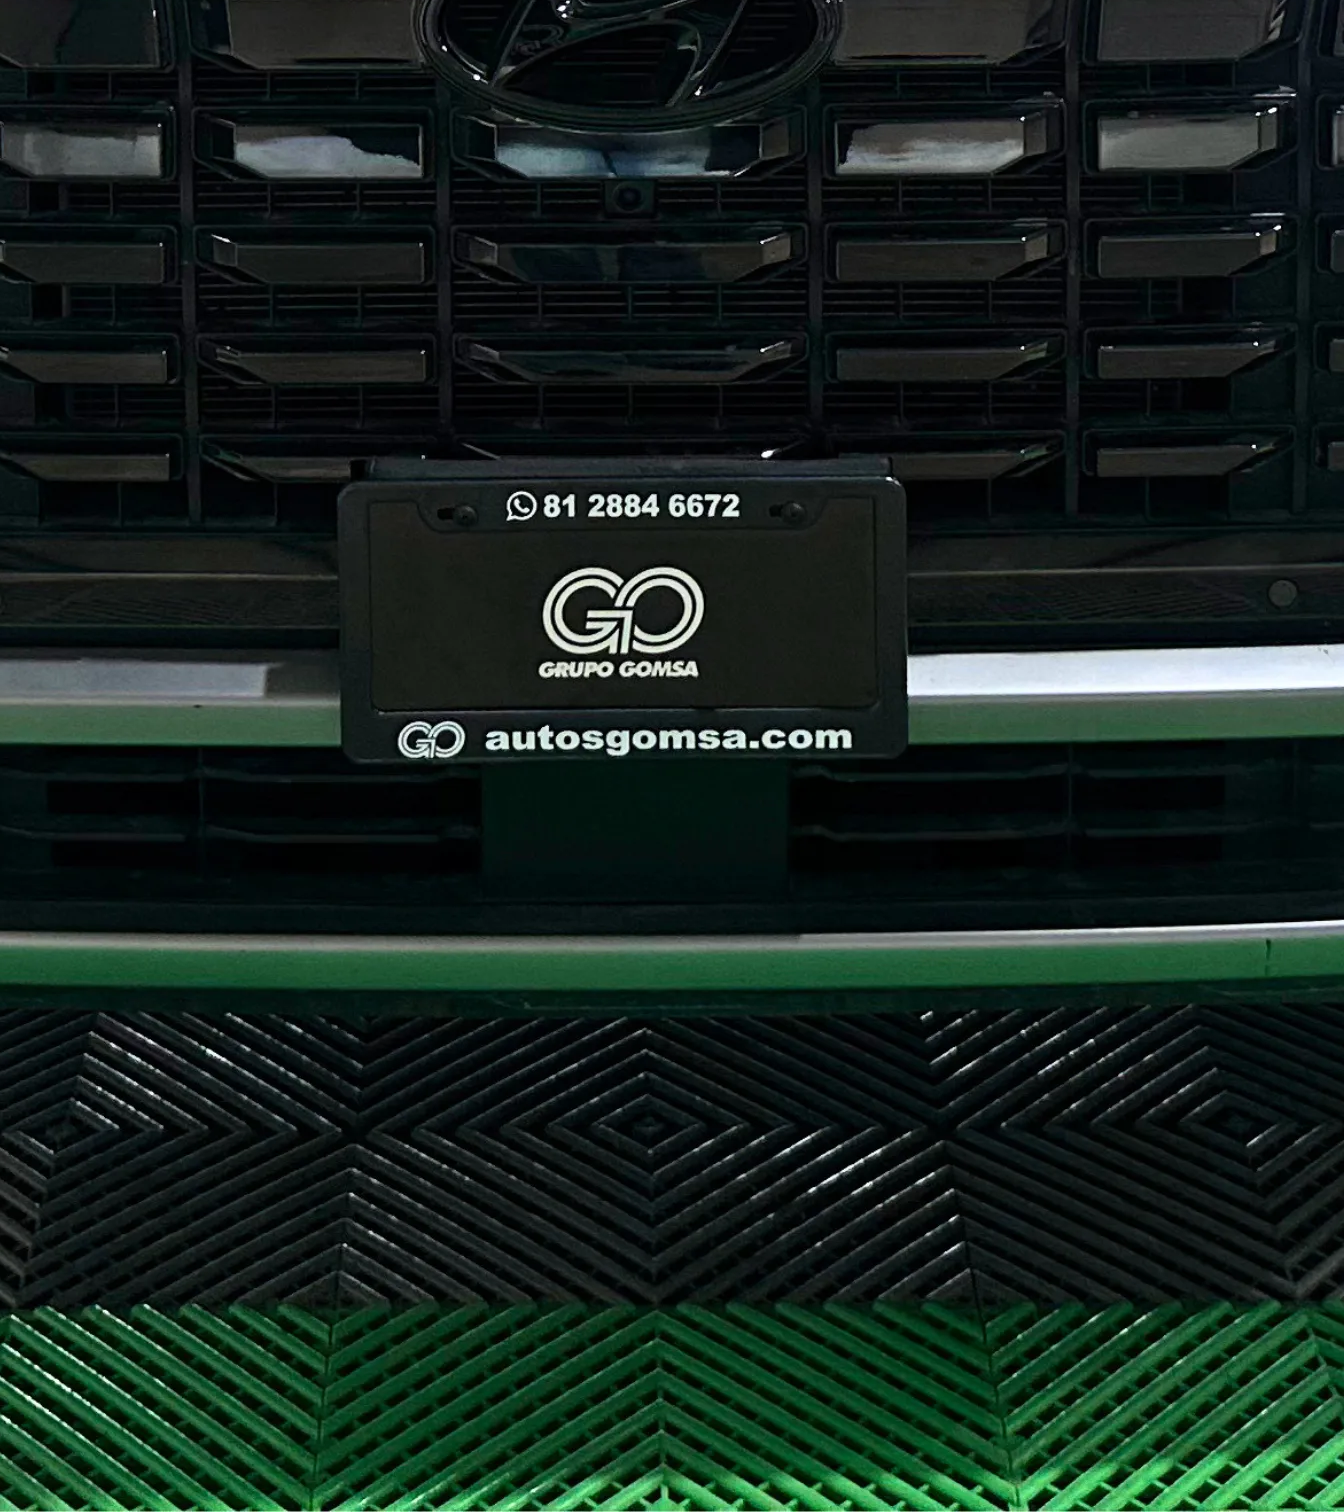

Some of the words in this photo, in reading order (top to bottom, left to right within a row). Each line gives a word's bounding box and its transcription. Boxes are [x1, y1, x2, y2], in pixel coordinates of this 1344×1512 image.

[543, 493, 577, 518] 81
[587, 493, 661, 518] 2884
[668, 493, 741, 518] 6672
[538, 661, 615, 678] GRUPO
[618, 660, 699, 678] GOMSA
[485, 725, 852, 757] autosgomsa.com
